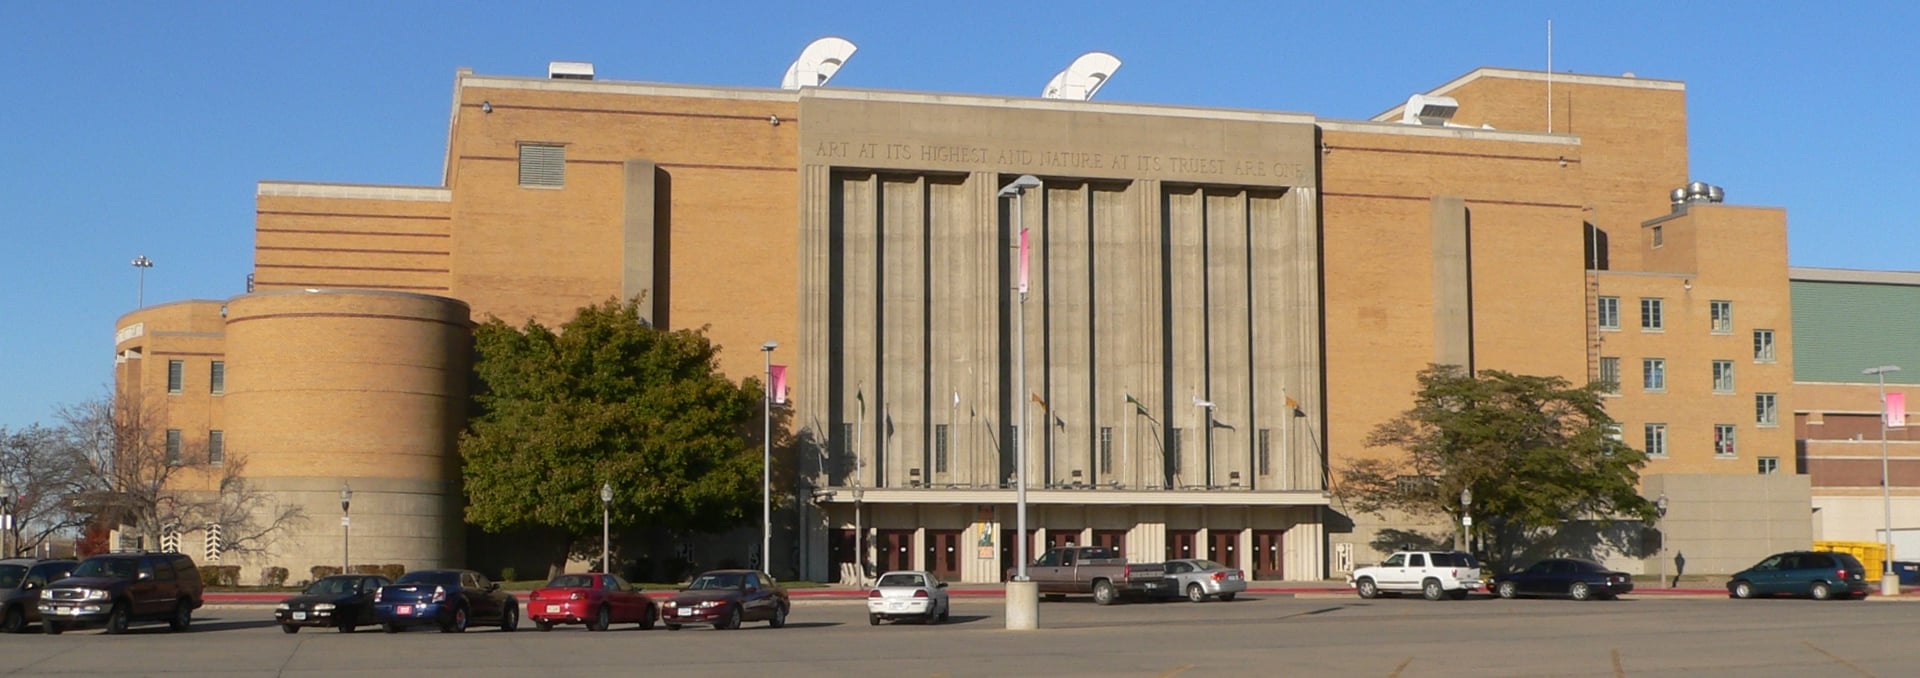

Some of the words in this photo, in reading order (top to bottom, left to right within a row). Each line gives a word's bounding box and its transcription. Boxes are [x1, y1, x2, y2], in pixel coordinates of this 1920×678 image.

[816, 141, 850, 159] ART
[858, 143, 878, 159] AT
[887, 144, 912, 160] ITS
[920, 145, 989, 164] HIGHEST
[997, 149, 1033, 166] AND
[1040, 151, 1104, 169] NATURE
[1111, 154, 1129, 170] AT
[1137, 155, 1161, 172] ITS
[1169, 157, 1226, 175] TRUEST
[1234, 160, 1267, 177] ARE
[1272, 161, 1304, 178] ONE
